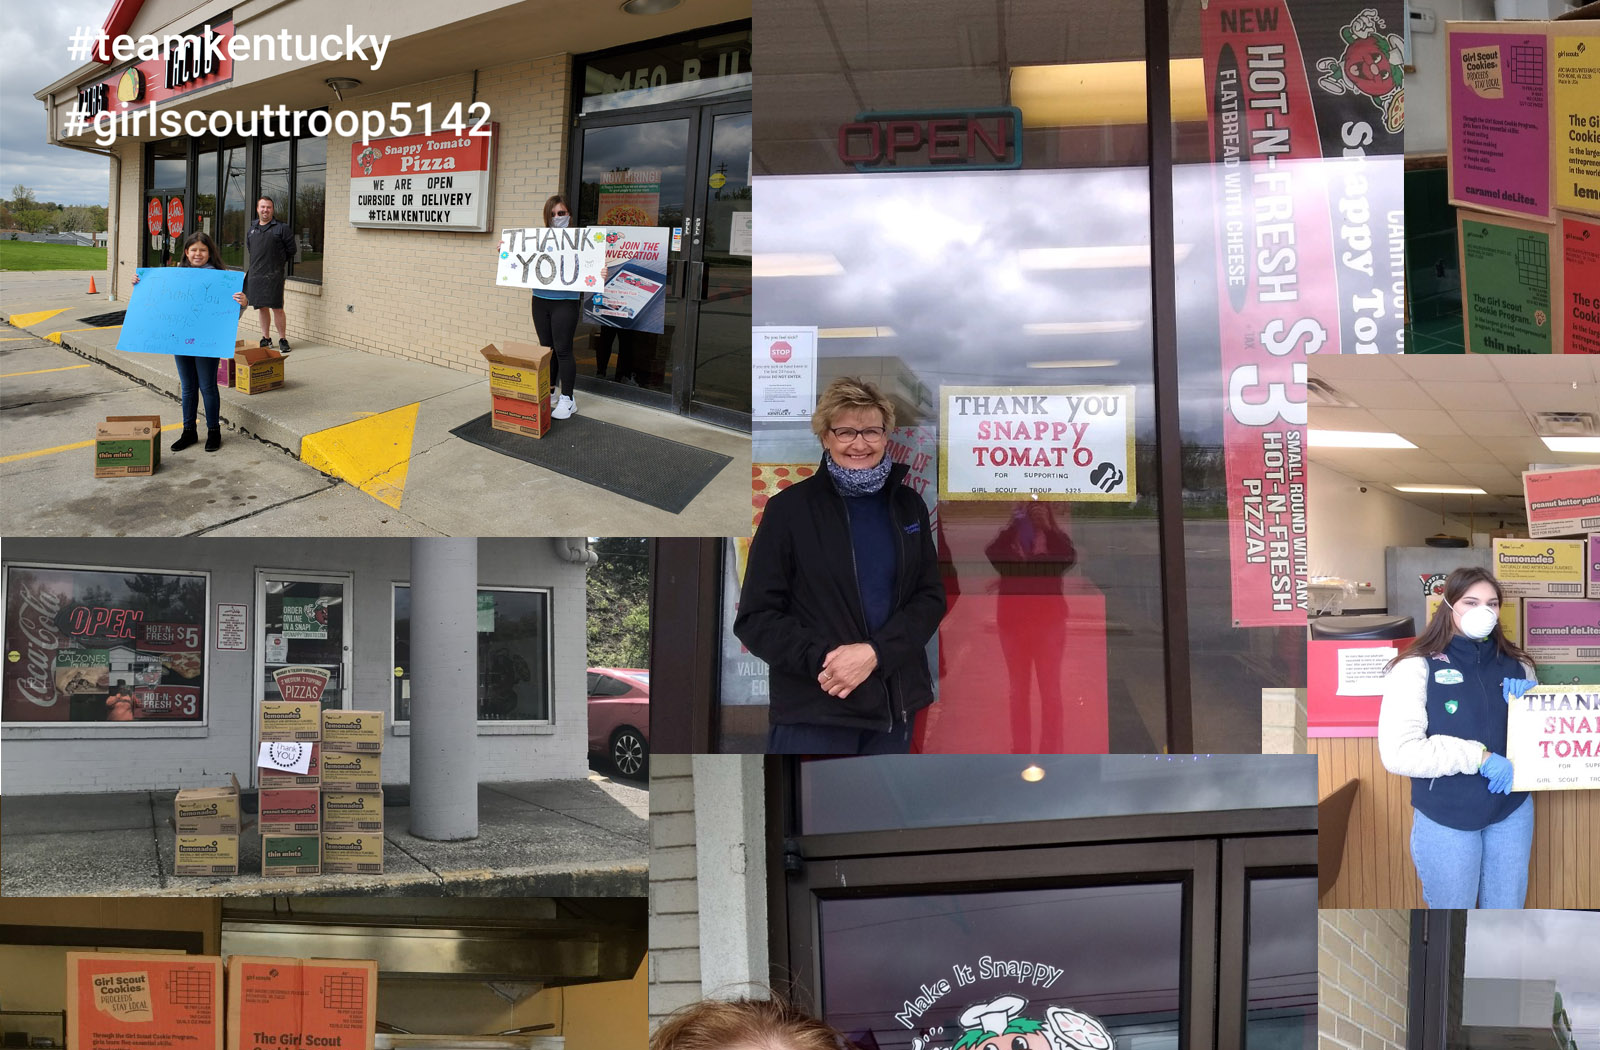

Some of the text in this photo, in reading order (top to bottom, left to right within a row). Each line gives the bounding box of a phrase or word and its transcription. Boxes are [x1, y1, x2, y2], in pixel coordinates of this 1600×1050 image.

[1220, 7, 1280, 34] NEW
[1569, 115, 1587, 128] The
[385, 137, 472, 155] Snappy Tomato
[838, 118, 1008, 166] OPEN
[400, 154, 456, 172] Pizza
[373, 176, 453, 190] WE ARE OPEN
[1246, 43, 1297, 305] HOT-N-FRESH
[357, 191, 472, 207] CURBSIDE OR DELIVERY
[368, 209, 452, 223] #TEAMKENTUCKY
[502, 228, 595, 253] THANK
[619, 242, 660, 250] JOIN THE
[516, 252, 580, 285] YOU
[955, 394, 1119, 422] THANK YOU
[976, 420, 1089, 449] SNAPPY
[972, 446, 1093, 469] TOMATO
[994, 471, 1069, 480] FOR SUPPORTING
[971, 486, 988, 494] GIRL
[996, 486, 1018, 494] SCOUT
[1500, 552, 1553, 565] lemonades
[283, 606, 303, 615] ORDER
[283, 615, 304, 623] ONLINE
[68, 605, 144, 639] OPEN
[17, 584, 60, 707] Coca-Cola
[285, 685, 319, 699] PIZZAS
[894, 956, 1065, 1030] Make It Snappy
